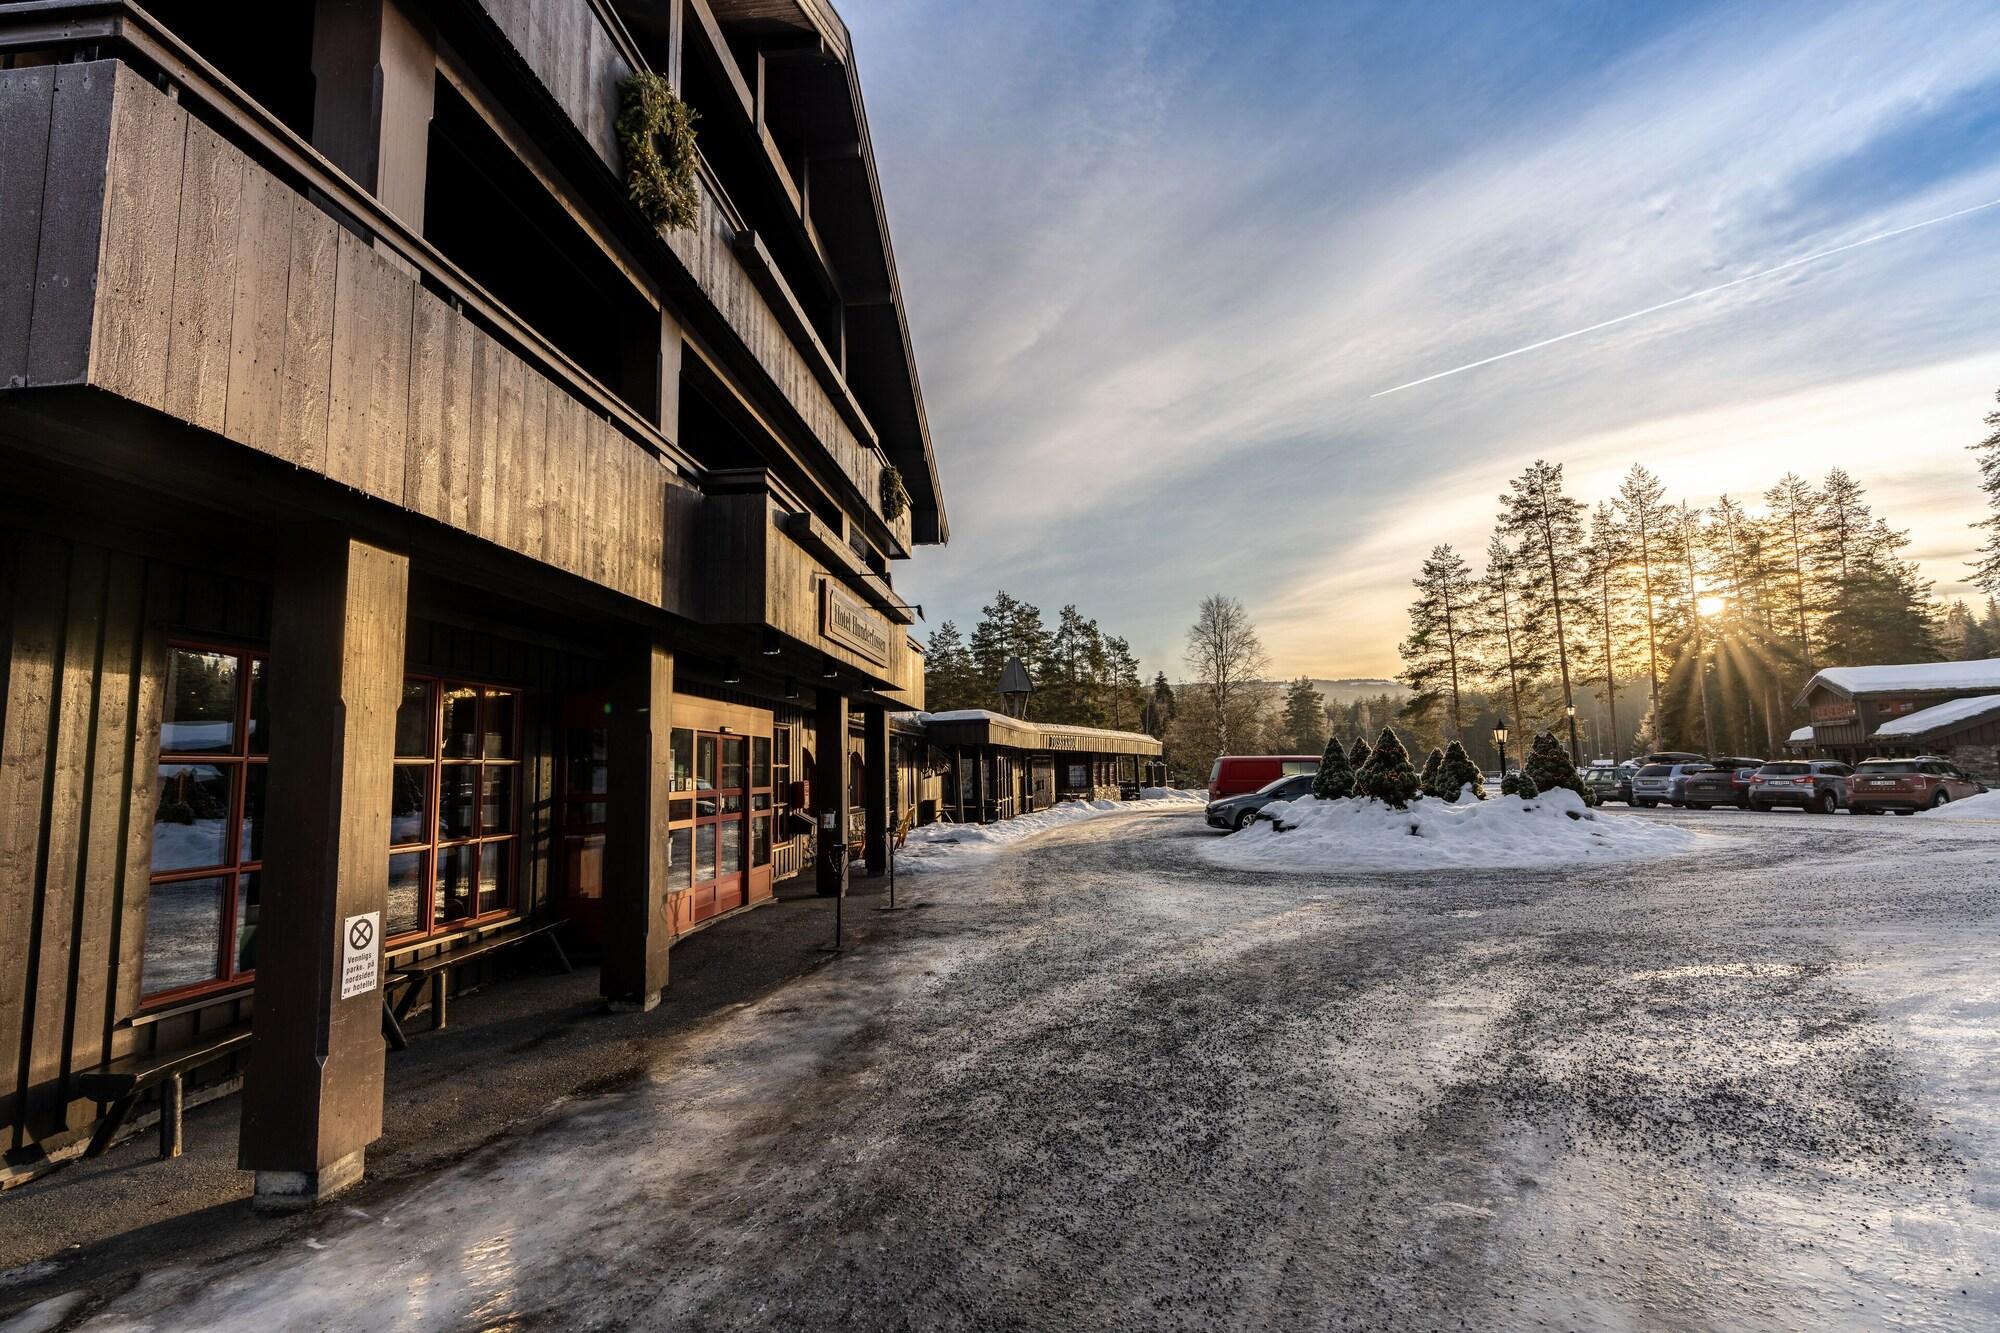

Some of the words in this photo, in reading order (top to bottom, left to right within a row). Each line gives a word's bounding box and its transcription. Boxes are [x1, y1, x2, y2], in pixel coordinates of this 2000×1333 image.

[833, 602, 851, 632] Hotel
[345, 971, 375, 984] nordsiden
[343, 986, 350, 994] av
[352, 979, 376, 991] hotellet
